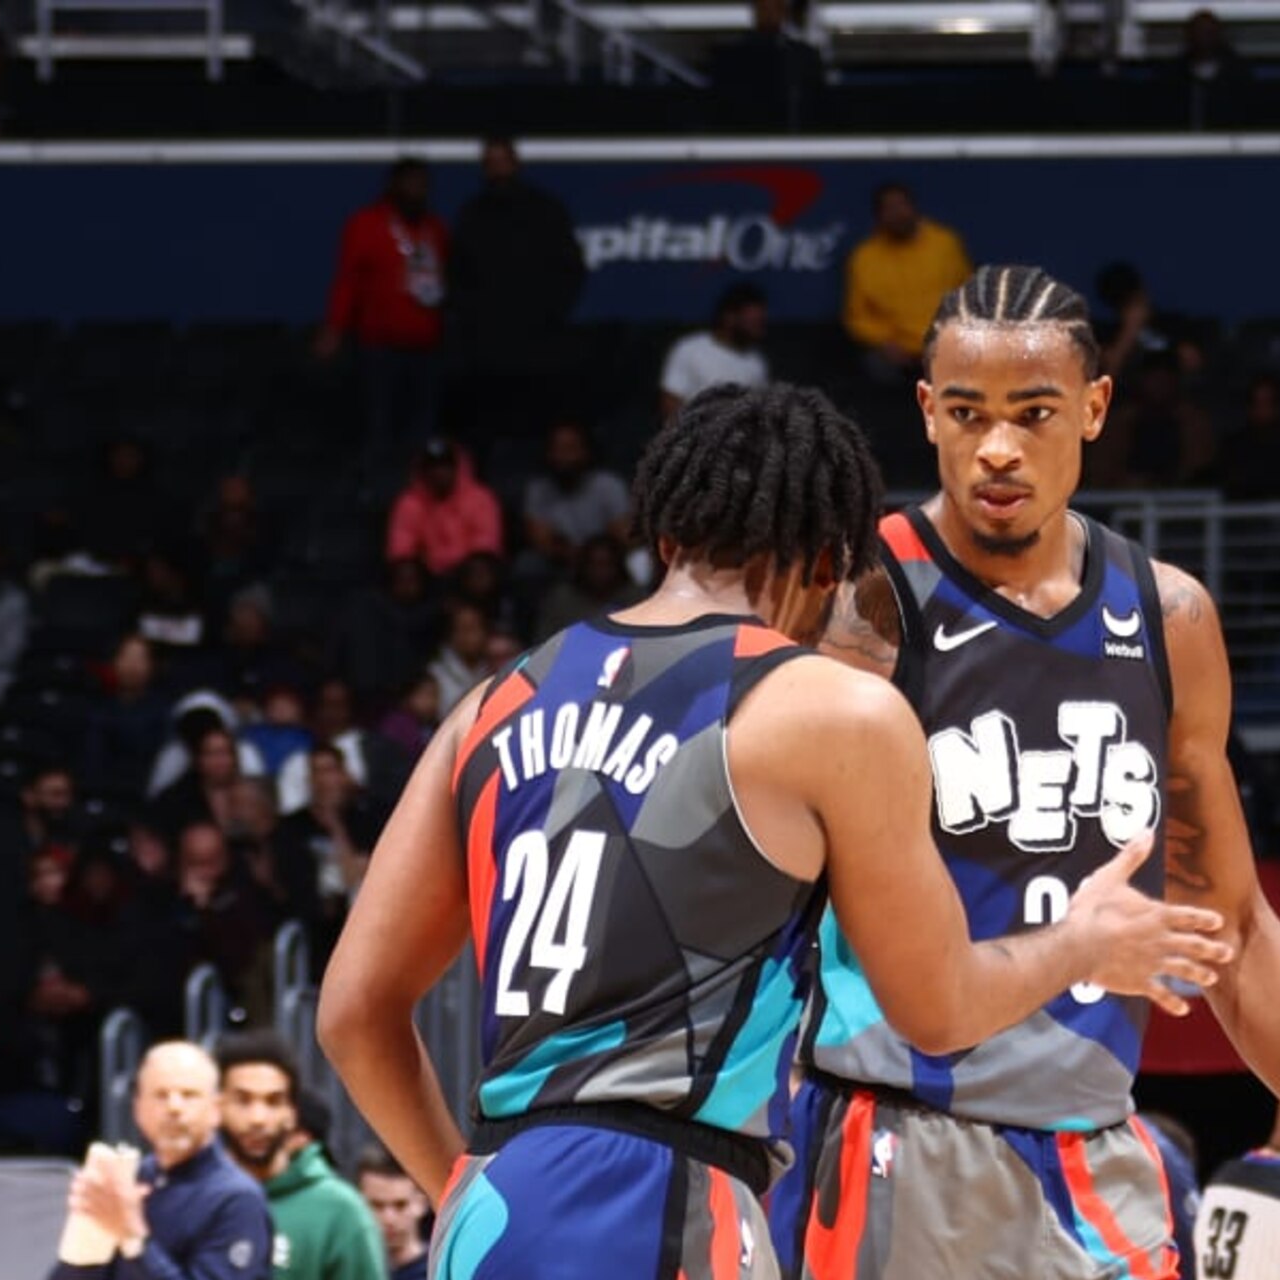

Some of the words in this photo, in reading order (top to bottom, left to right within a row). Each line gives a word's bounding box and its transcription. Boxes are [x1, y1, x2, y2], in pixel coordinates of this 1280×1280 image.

[492, 701, 680, 795] THOMAS
[927, 701, 1161, 853] NETS
[495, 829, 608, 1017] 24
